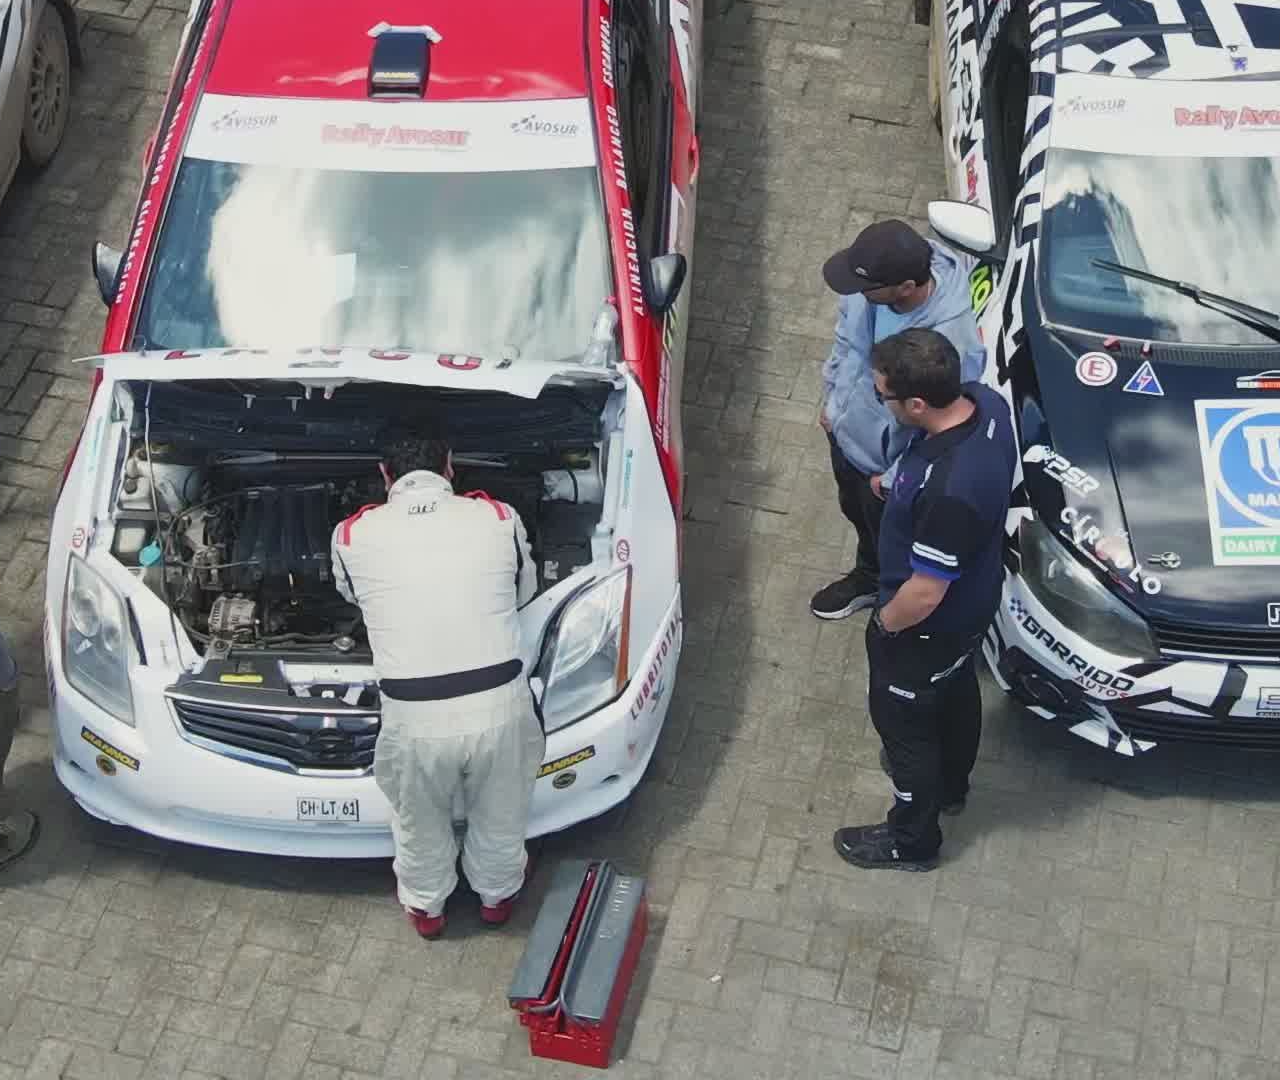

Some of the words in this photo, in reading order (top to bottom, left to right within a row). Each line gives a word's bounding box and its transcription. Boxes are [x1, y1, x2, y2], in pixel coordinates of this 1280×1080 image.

[526, 122, 579, 136] AVOSUR
[1175, 106, 1237, 130] Rally
[622, 207, 644, 317] ALINEACION
[1224, 538, 1278, 553] DAIRY
[1022, 615, 1135, 692] GARRIDO
